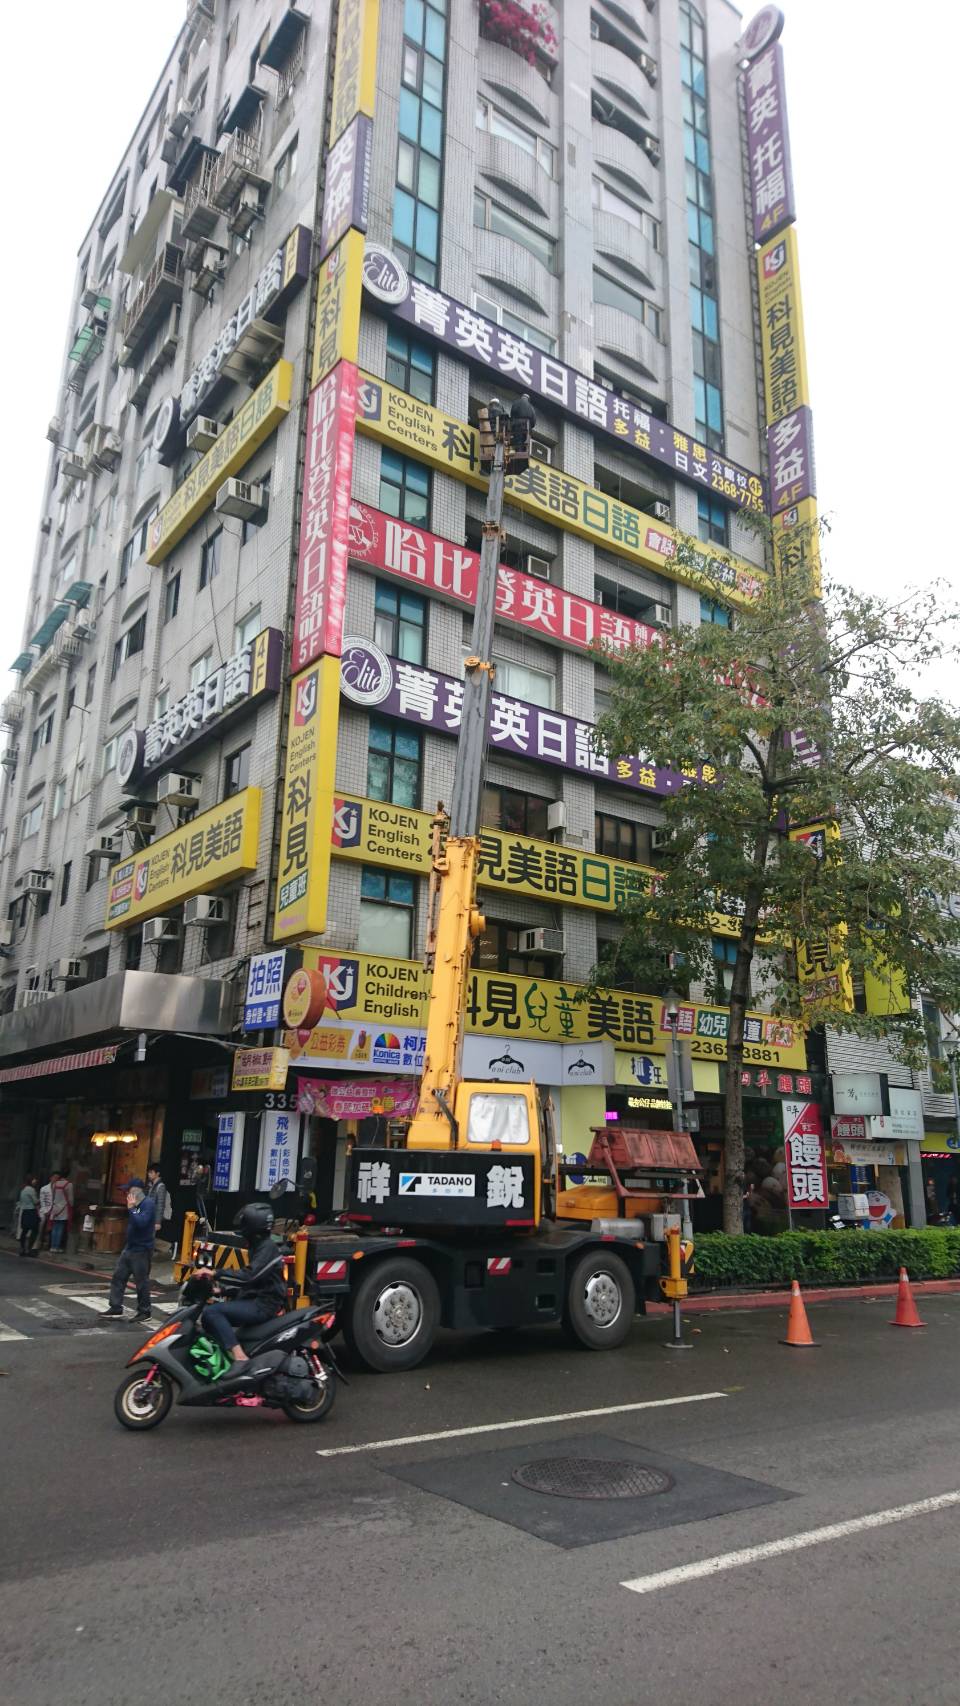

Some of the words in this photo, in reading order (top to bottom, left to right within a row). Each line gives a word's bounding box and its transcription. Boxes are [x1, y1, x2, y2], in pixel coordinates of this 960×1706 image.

[760, 205, 785, 231] 4F
[364, 252, 399, 291] Elite
[411, 279, 608, 428] 菁英英日語
[766, 294, 798, 410] 科見美語
[388, 392, 434, 422] KOJEN
[388, 406, 435, 438] English
[387, 423, 438, 451] Centers
[773, 414, 804, 491] 多益
[442, 419, 640, 549] 科美語日語
[712, 473, 764, 512] 2368-7755
[777, 482, 803, 506] 4F
[341, 649, 381, 691] Elite
[289, 740, 316, 761] English
[290, 728, 315, 749] KOJEN
[289, 753, 317, 774] Centers
[283, 769, 312, 877] 科見
[369, 808, 418, 830] KOJEN
[171, 807, 243, 883] 科見美語
[368, 824, 420, 847] English
[367, 841, 423, 863] Centers
[429, 820, 647, 906] 見美語日語
[249, 956, 283, 998] 拍照
[366, 964, 418, 982] KOJEN
[365, 982, 430, 1001] Children'
[364, 1000, 418, 1018] English
[699, 1013, 727, 1037] 幼兒
[373, 1049, 400, 1060] Konica
[275, 1116, 288, 1146] 飛影
[281, 1149, 290, 1177] 彩色沖
[788, 1132, 825, 1203] 饅頭
[357, 1161, 391, 1204] 祥
[427, 1176, 473, 1187] TADANO
[487, 1165, 525, 1208] 銳
